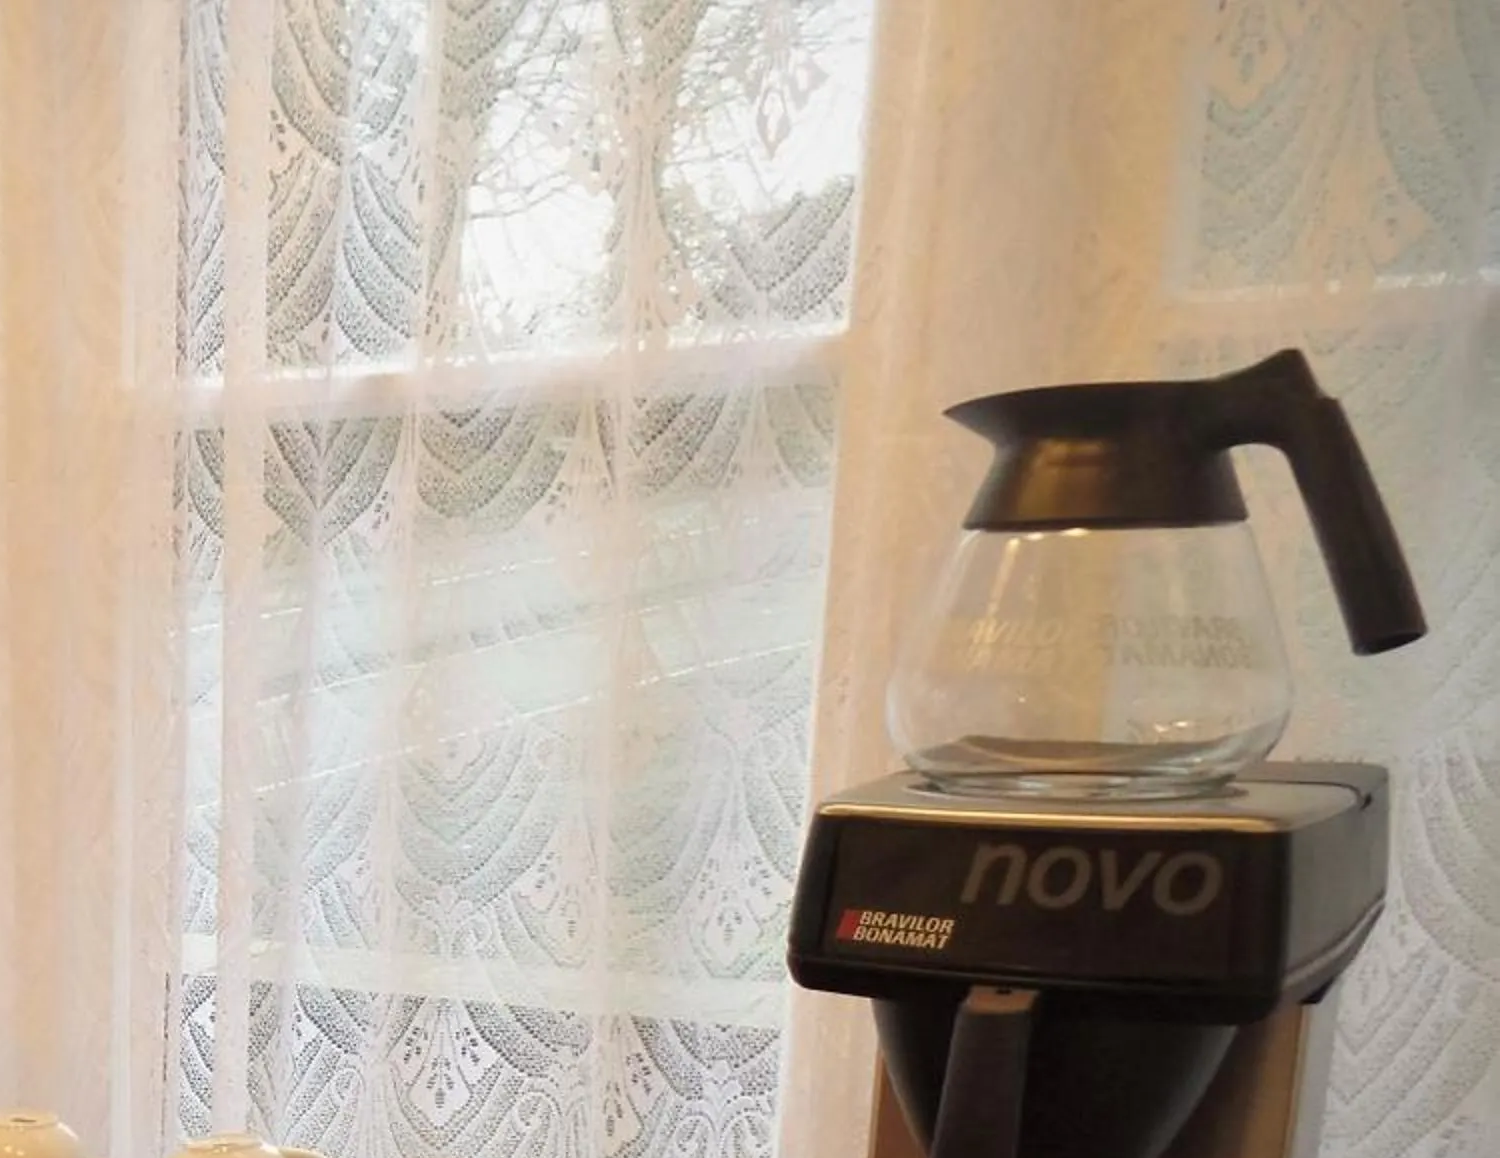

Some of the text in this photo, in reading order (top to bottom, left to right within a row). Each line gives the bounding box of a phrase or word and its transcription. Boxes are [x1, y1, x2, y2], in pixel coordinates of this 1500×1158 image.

[960, 844, 1223, 915] novo
[859, 911, 955, 934] BRAVILOR
[852, 926, 949, 949] BONAMAT
